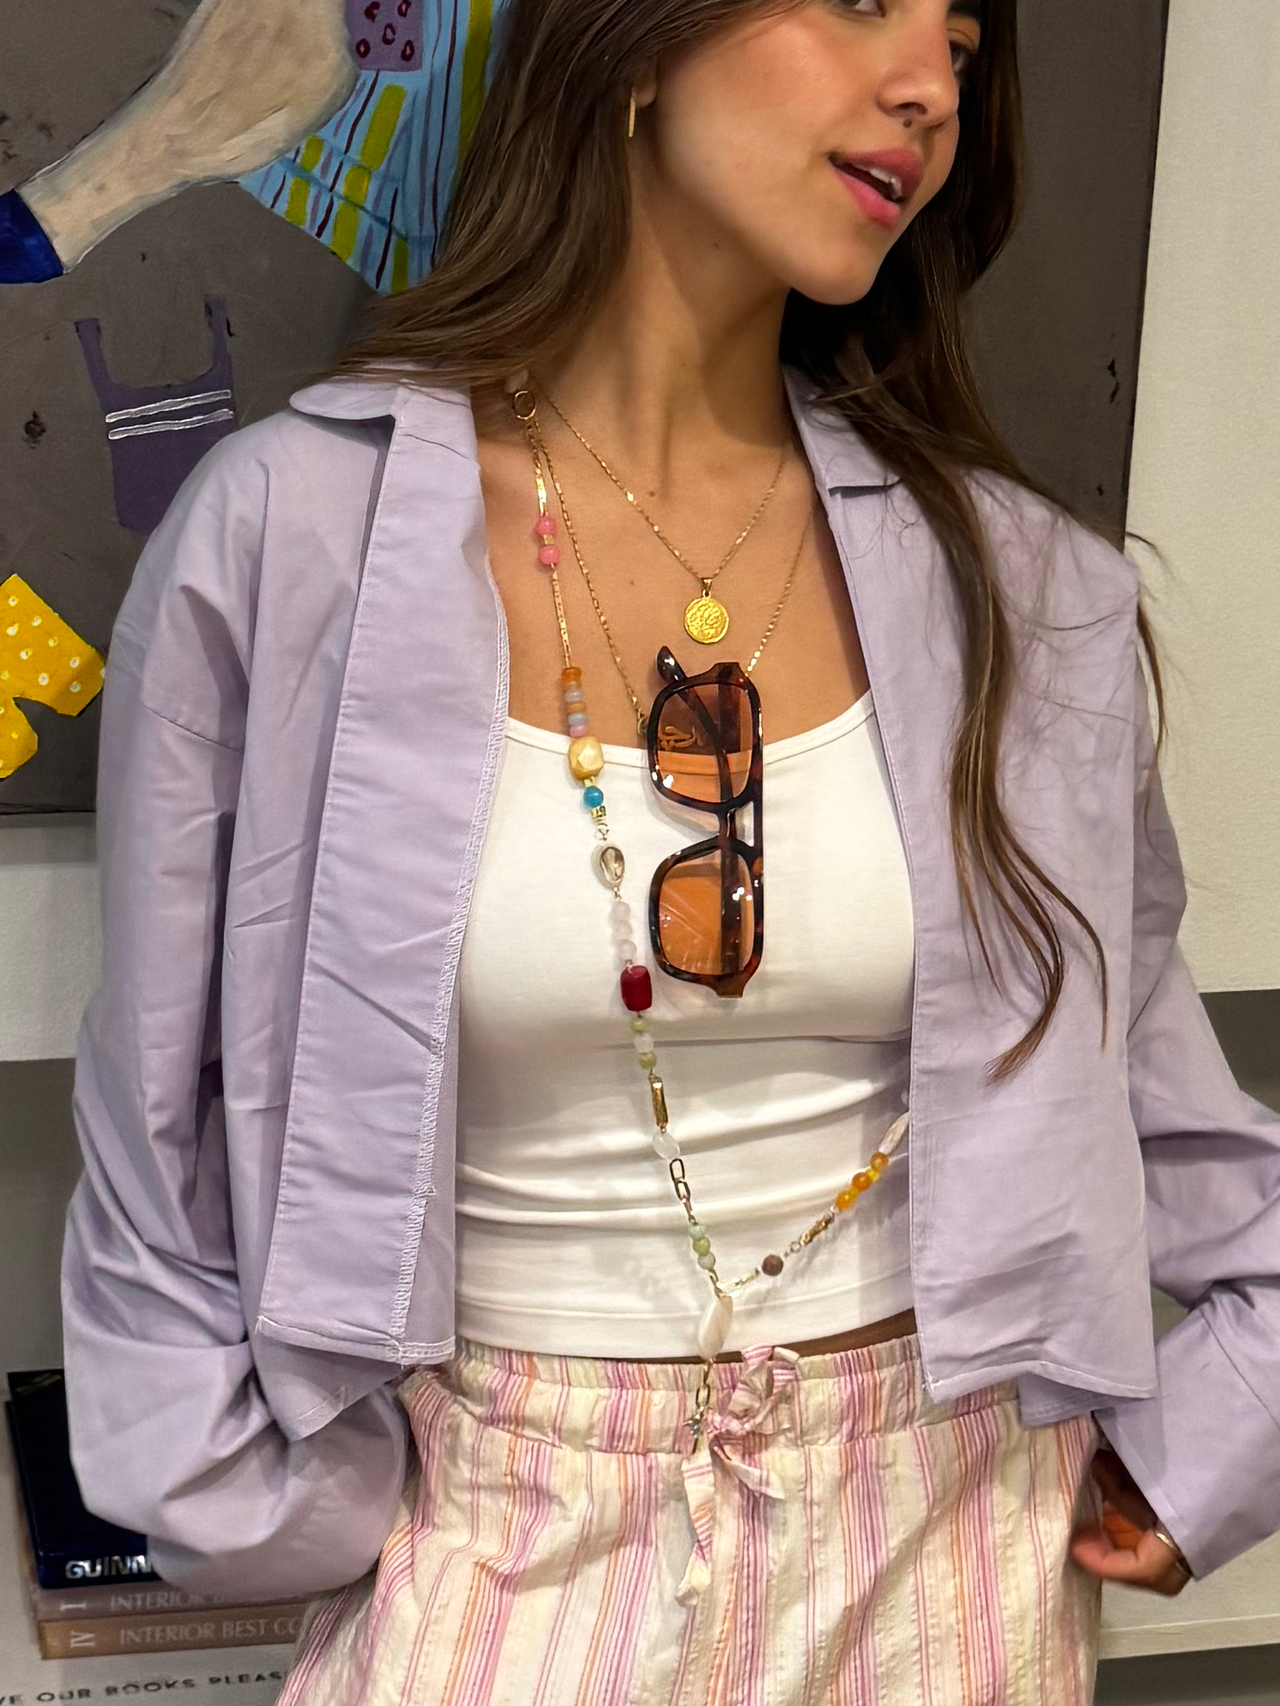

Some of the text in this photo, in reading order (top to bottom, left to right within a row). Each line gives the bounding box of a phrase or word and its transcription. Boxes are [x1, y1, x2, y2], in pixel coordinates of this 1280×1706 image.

[65, 1554, 152, 1580] GUINN
[120, 1622, 217, 1645] INTERIOR
[222, 1617, 269, 1638] BEST
[36, 1688, 91, 1702] OUR
[104, 1678, 197, 1696] BOOKS
[208, 1670, 287, 1685] PLEAS
